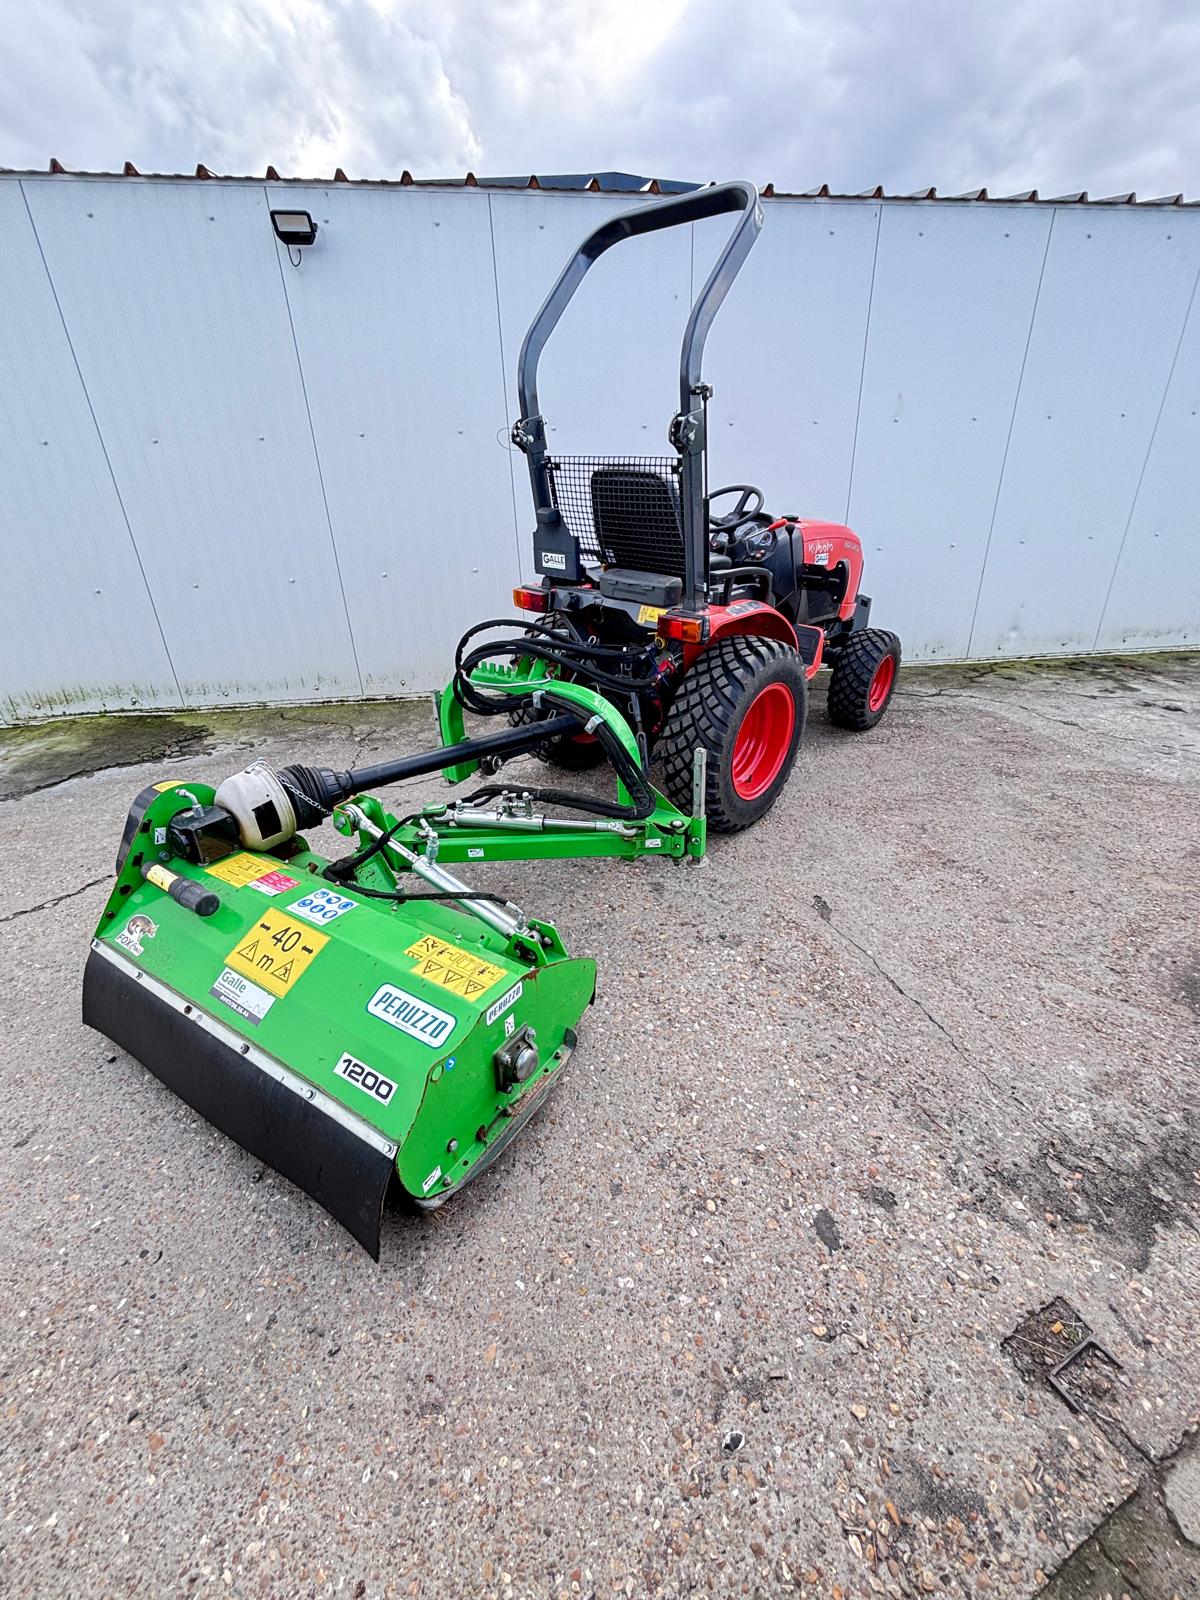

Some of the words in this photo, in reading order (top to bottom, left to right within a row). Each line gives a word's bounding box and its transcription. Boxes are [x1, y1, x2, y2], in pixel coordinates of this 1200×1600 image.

[543, 553, 565, 564] GALLE
[808, 541, 834, 555] Kubota
[116, 933, 134, 947] FOX
[271, 926, 302, 952] 40
[256, 954, 274, 972] m
[221, 971, 247, 993] Galle
[488, 985, 521, 1021] PERUZZO
[374, 991, 449, 1039] PERUZZO
[342, 1059, 394, 1100] 1200
